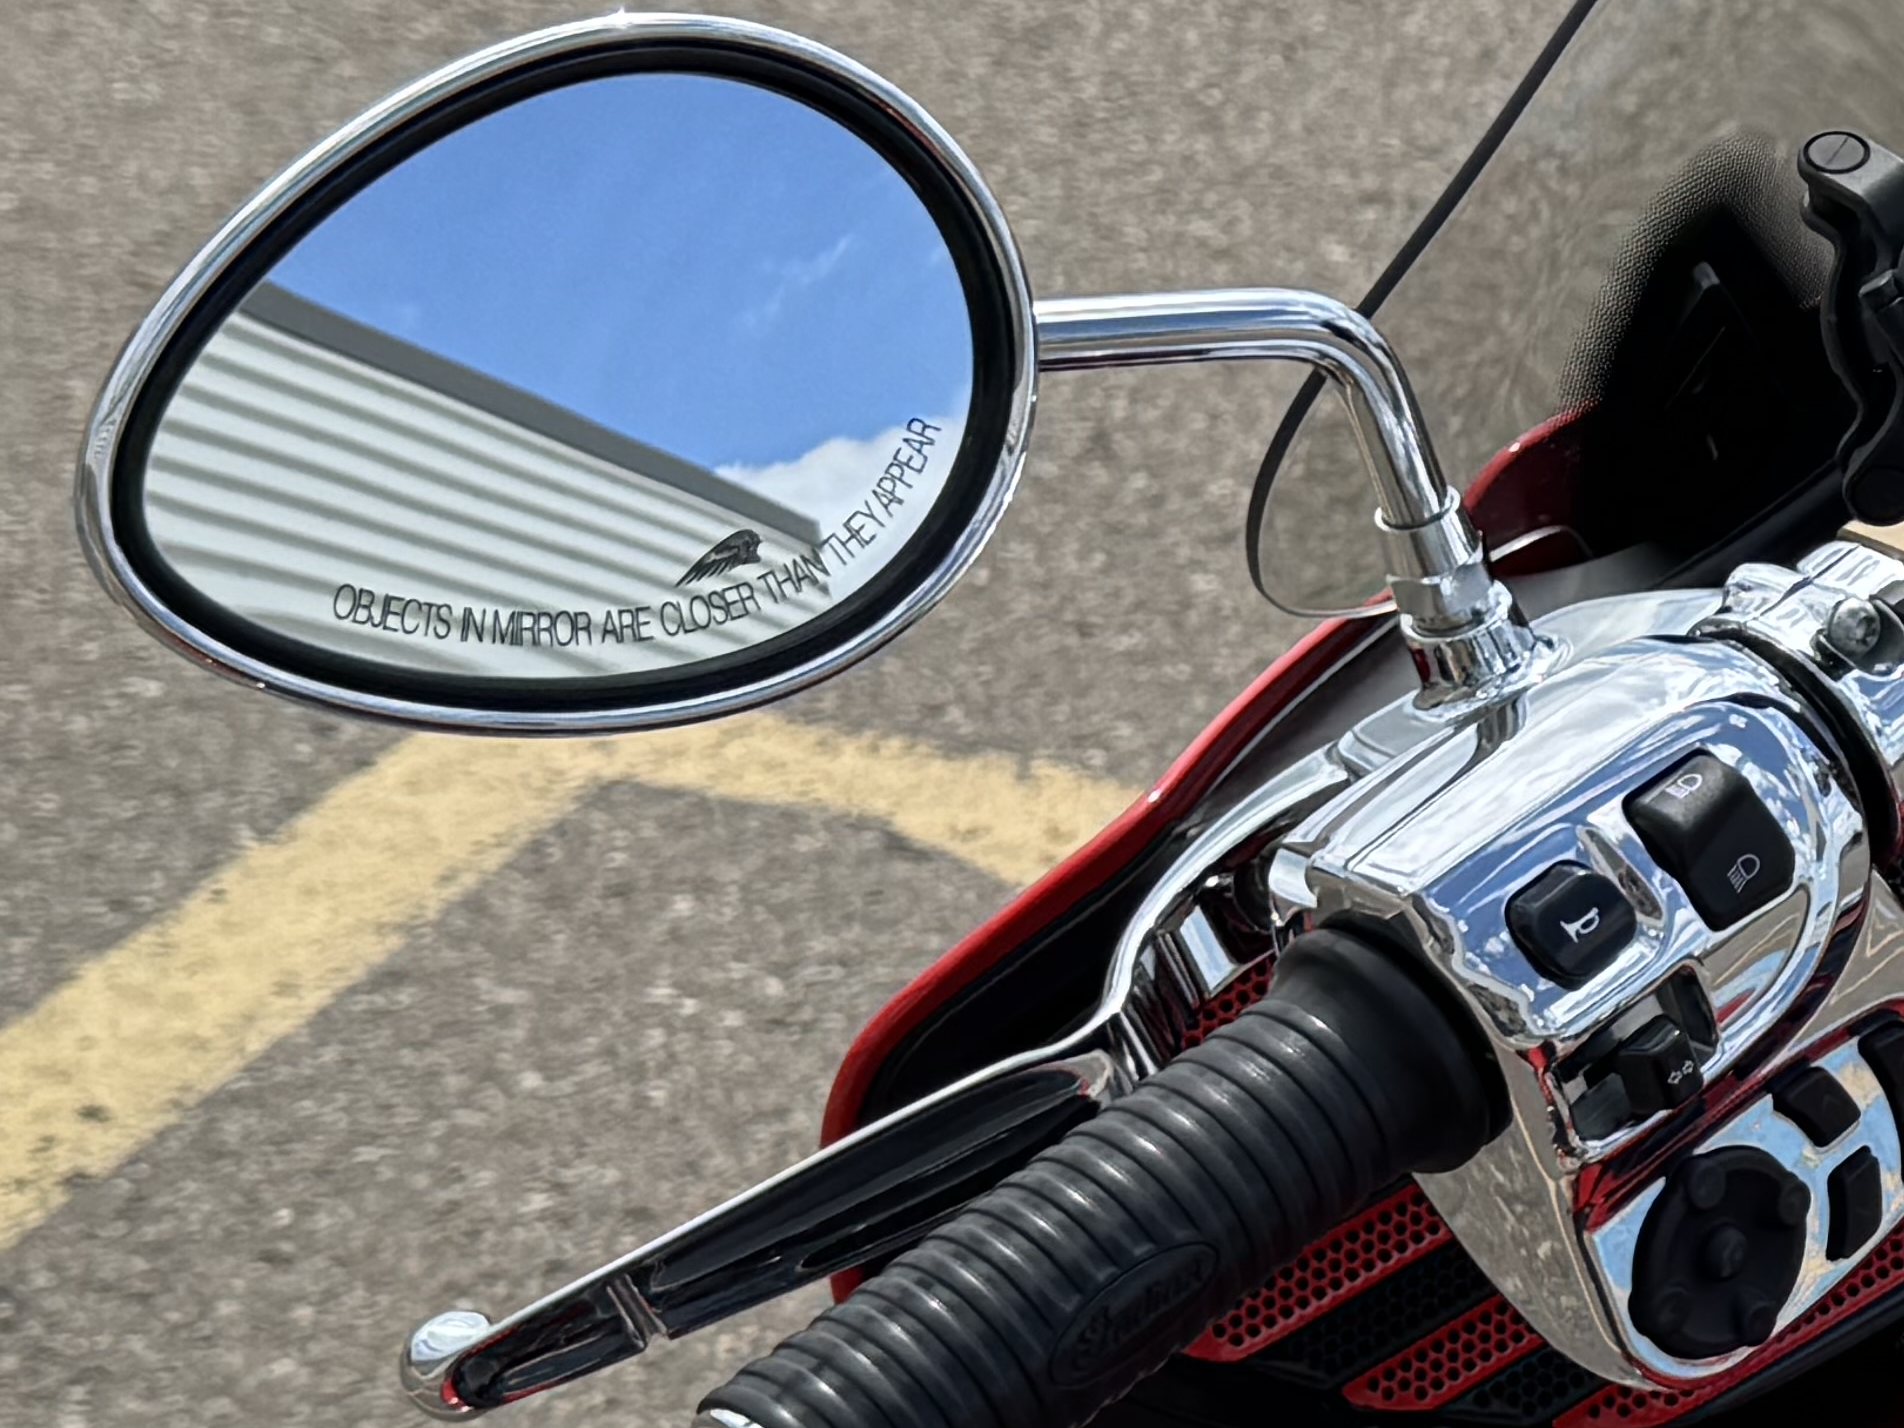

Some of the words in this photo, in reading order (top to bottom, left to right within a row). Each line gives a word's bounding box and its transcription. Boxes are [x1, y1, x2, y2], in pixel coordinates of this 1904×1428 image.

[333, 583, 452, 639] OBJECTS
[460, 607, 487, 643] IN
[492, 609, 592, 647] MIRROR
[602, 606, 655, 644] ARE
[660, 582, 761, 637] CLOSER
[757, 548, 831, 604] THAN
[819, 500, 886, 566] THEY
[872, 417, 942, 518] APPEAR
